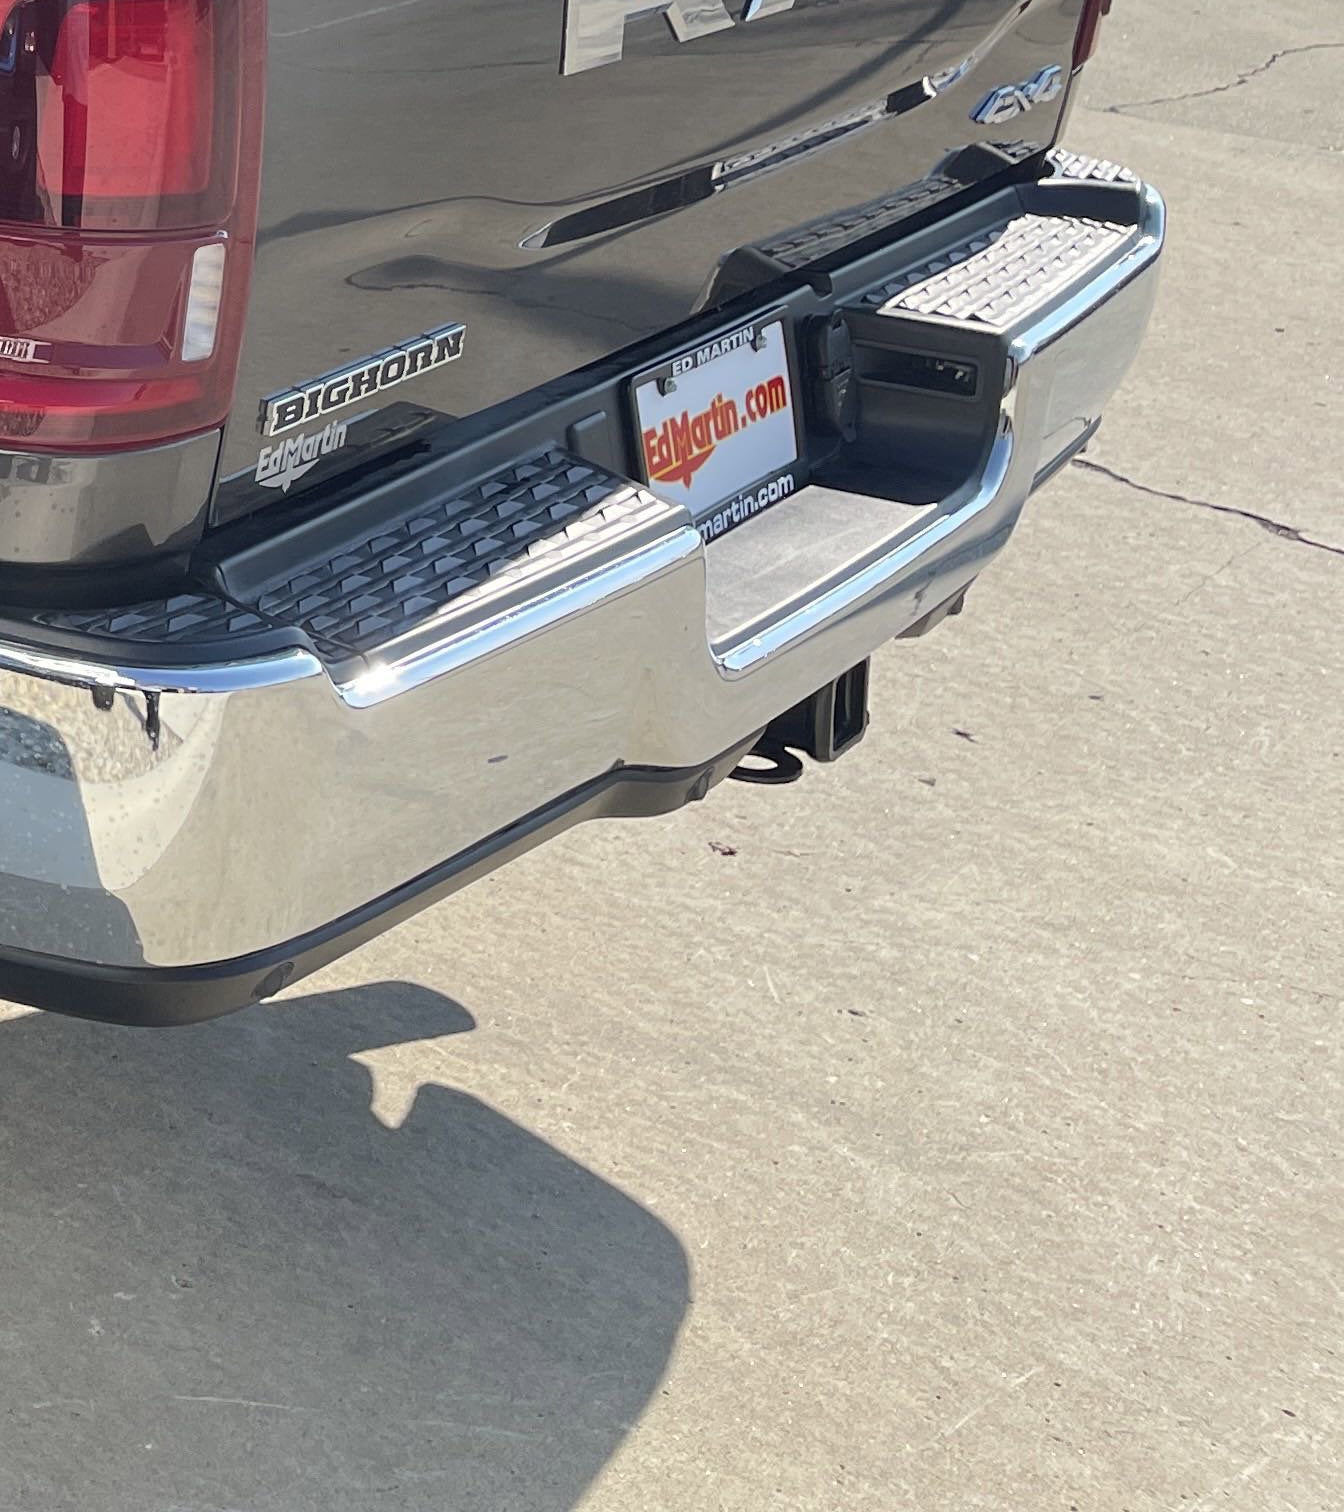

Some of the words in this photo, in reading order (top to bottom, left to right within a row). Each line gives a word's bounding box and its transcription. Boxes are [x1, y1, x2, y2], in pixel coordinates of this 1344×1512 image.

[268, 324, 467, 437] BIGHORN
[670, 355, 694, 377] ED
[696, 325, 754, 369] MARTIN
[255, 420, 348, 485] EdMartin
[643, 375, 787, 480] EdMartin.com
